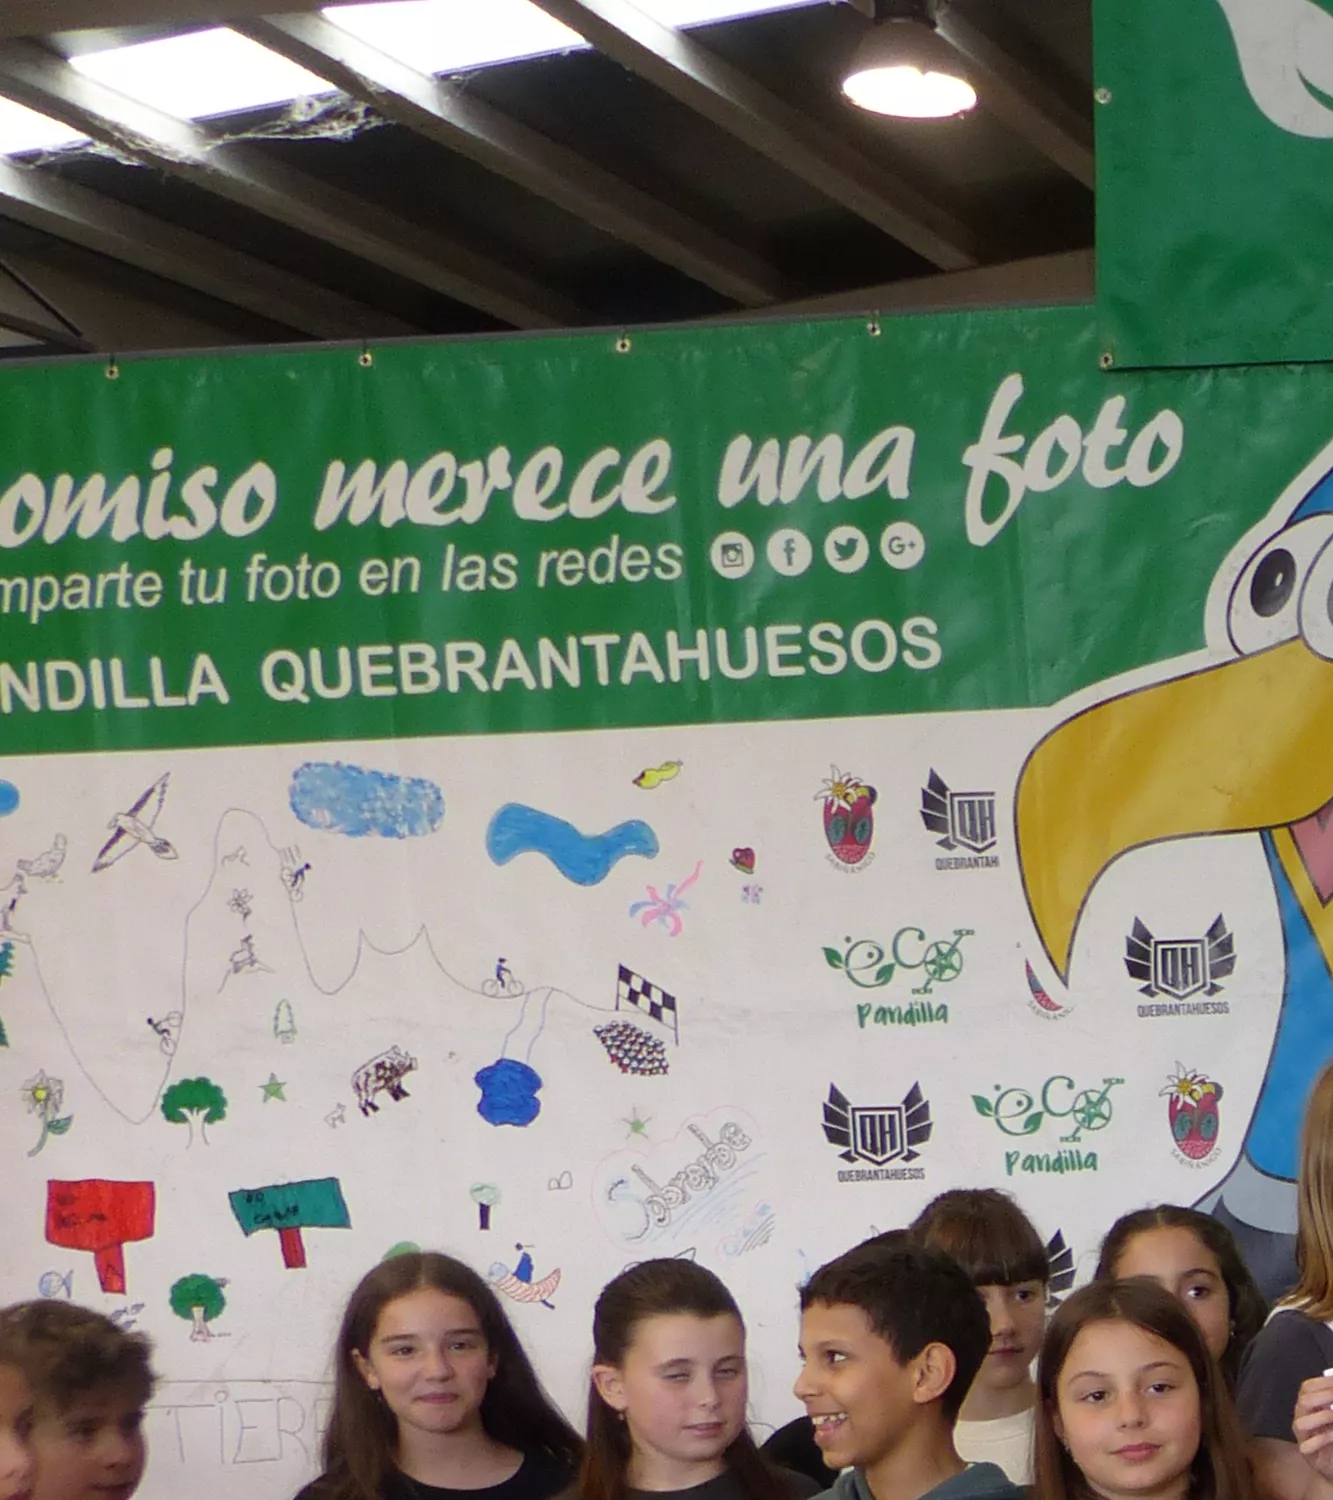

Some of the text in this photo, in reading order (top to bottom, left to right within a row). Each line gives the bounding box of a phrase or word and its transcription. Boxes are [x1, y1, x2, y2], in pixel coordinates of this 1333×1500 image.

[314, 434, 678, 532] merece
[717, 424, 916, 509] una
[961, 372, 1184, 547] foto
[181, 557, 227, 604] tu
[246, 552, 342, 602] foto
[358, 553, 423, 596] en
[441, 544, 519, 593] las
[537, 533, 685, 588] redes
[0, 616, 943, 713] NDILLA QUEBRANTAHUESOS
[856, 1000, 949, 1030] Pandilla
[1137, 1001, 1230, 1019] QUEBRANTAHUESOS
[837, 1168, 926, 1183] QUEBRANTAHUESOS
[1005, 1148, 1098, 1177] Pandilla
